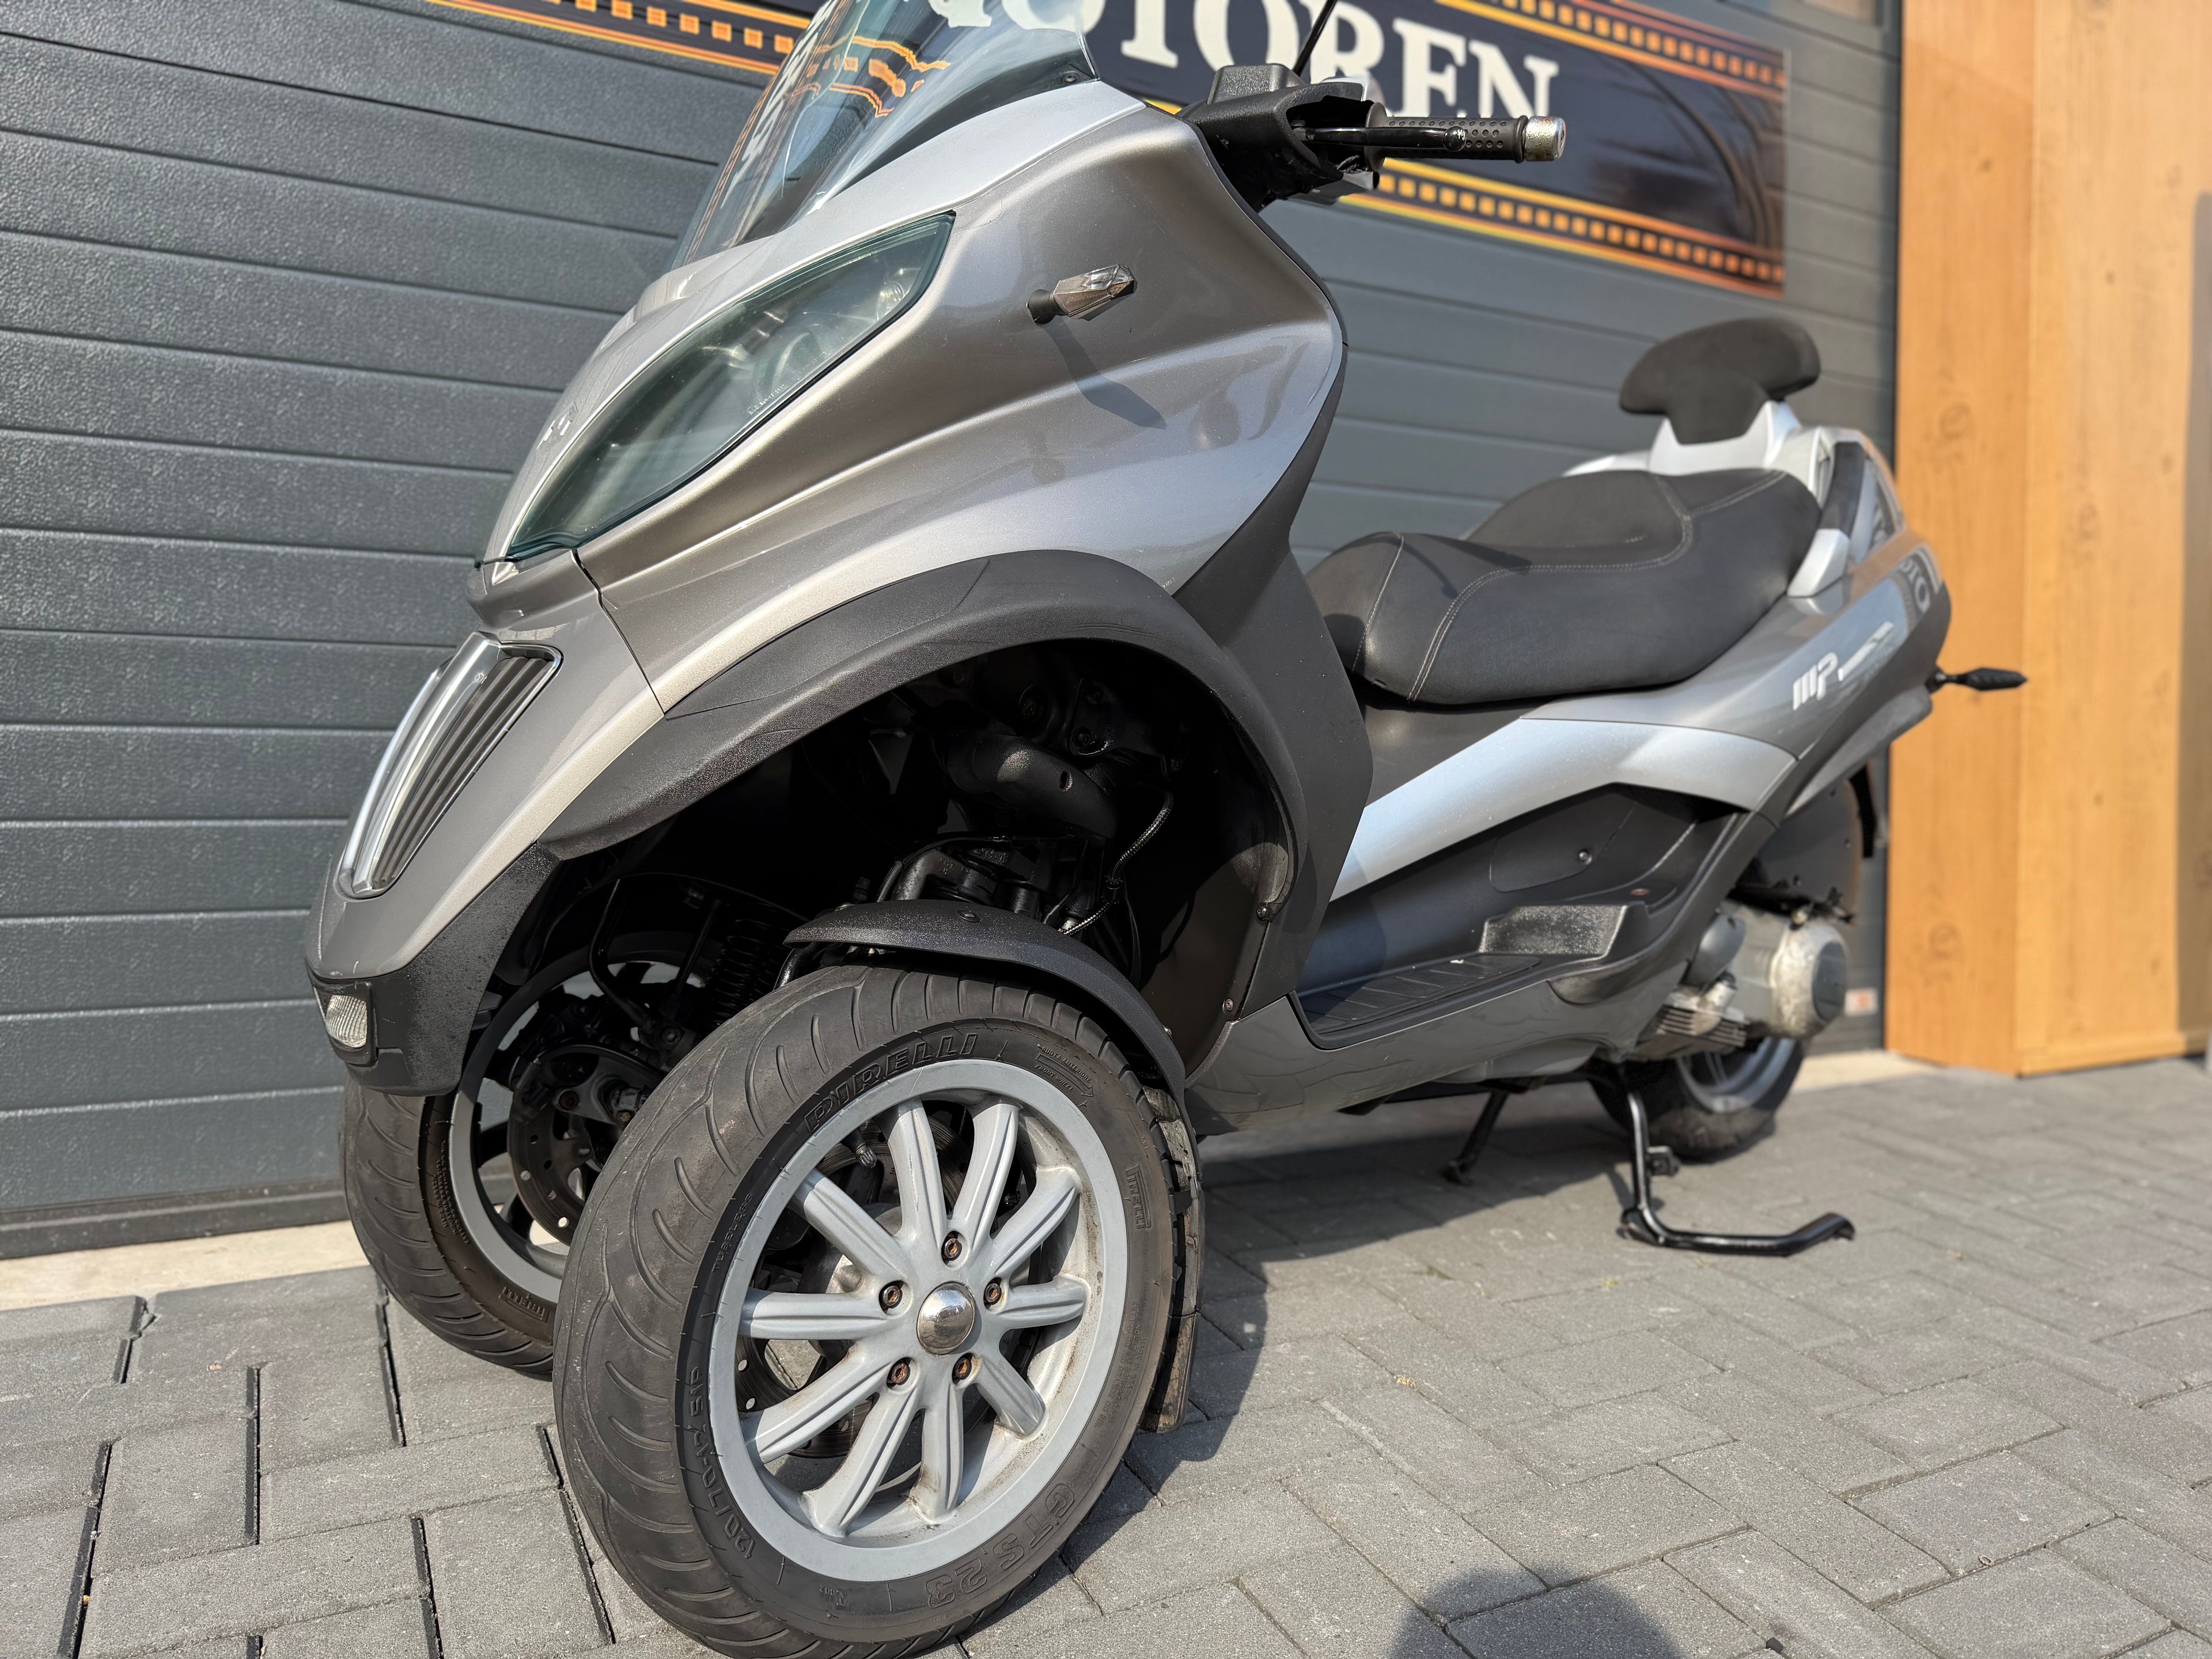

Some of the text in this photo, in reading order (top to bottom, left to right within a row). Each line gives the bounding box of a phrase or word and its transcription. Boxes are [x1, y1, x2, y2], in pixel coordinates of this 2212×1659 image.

[804, 1033, 978, 1133] PIRELLI
[1035, 1064, 1073, 1092] FRONT WHEEL
[1042, 1046, 1092, 1082] RUOTA ANTERIORE
[1125, 1163, 1151, 1229] PIRELLI
[712, 1194, 752, 1271] TUBELESS
[498, 1286, 550, 1323] PIRELLI
[689, 1367, 755, 1558] 120/70-12 51P
[926, 1483, 1074, 1608] GTS 23
